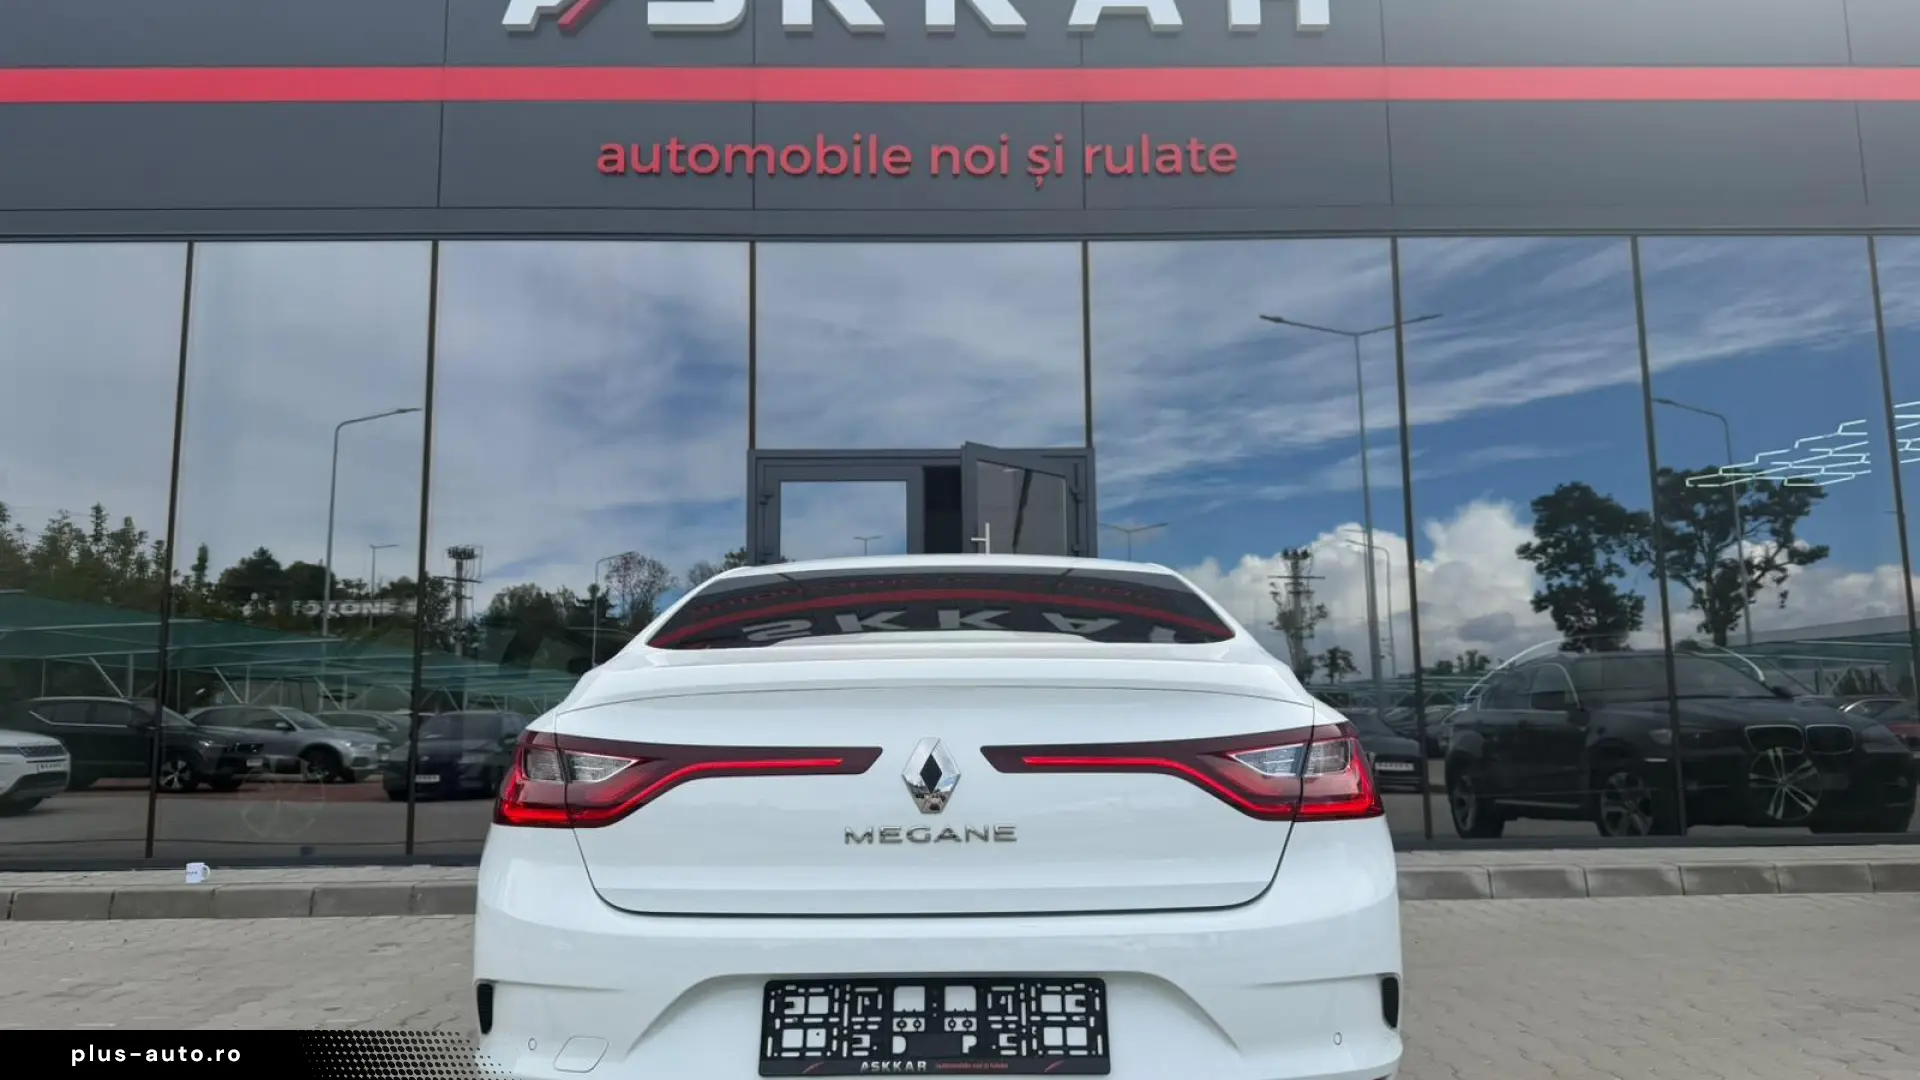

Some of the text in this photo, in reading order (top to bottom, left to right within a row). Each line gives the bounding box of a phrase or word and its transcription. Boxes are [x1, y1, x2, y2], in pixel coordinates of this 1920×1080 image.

[596, 132, 1238, 189] automobile noi și rulate
[844, 825, 1017, 844] MEGANE
[860, 1061, 927, 1073] ASKKAR
